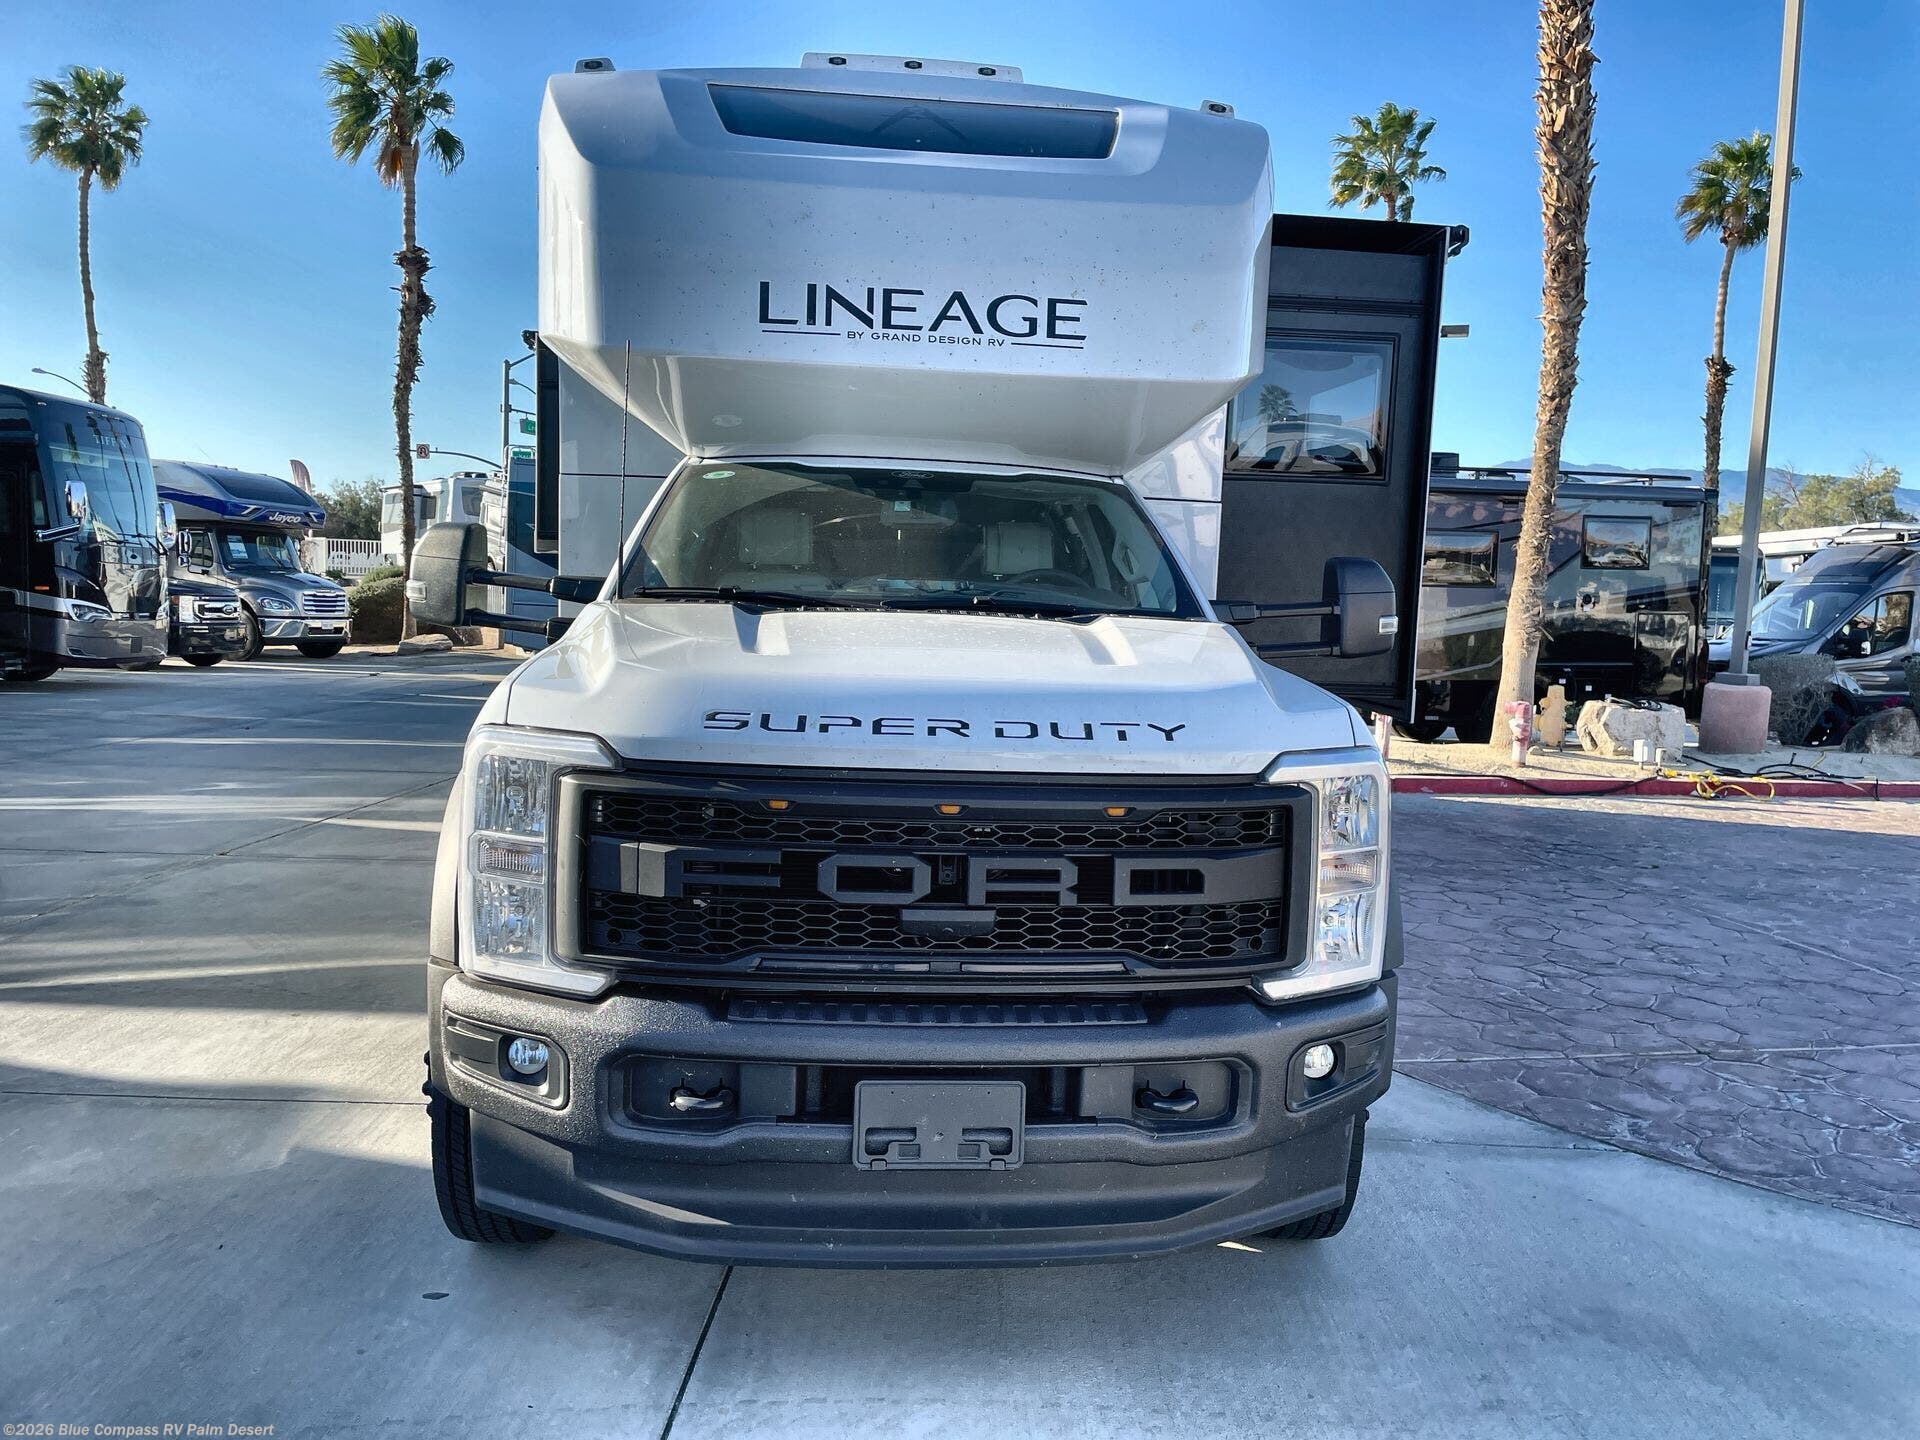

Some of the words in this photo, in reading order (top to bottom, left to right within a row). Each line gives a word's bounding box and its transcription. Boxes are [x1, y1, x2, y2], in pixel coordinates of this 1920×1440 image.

[758, 280, 1089, 341] LINEAGE
[847, 330, 865, 340] BY
[870, 331, 922, 343] GRAND
[927, 335, 982, 346] DESIGN
[987, 338, 1006, 347] RV
[268, 511, 301, 524] Jayco
[703, 710, 970, 738] SUPER
[993, 720, 1187, 742] DUTY
[640, 847, 1225, 907] FORD
